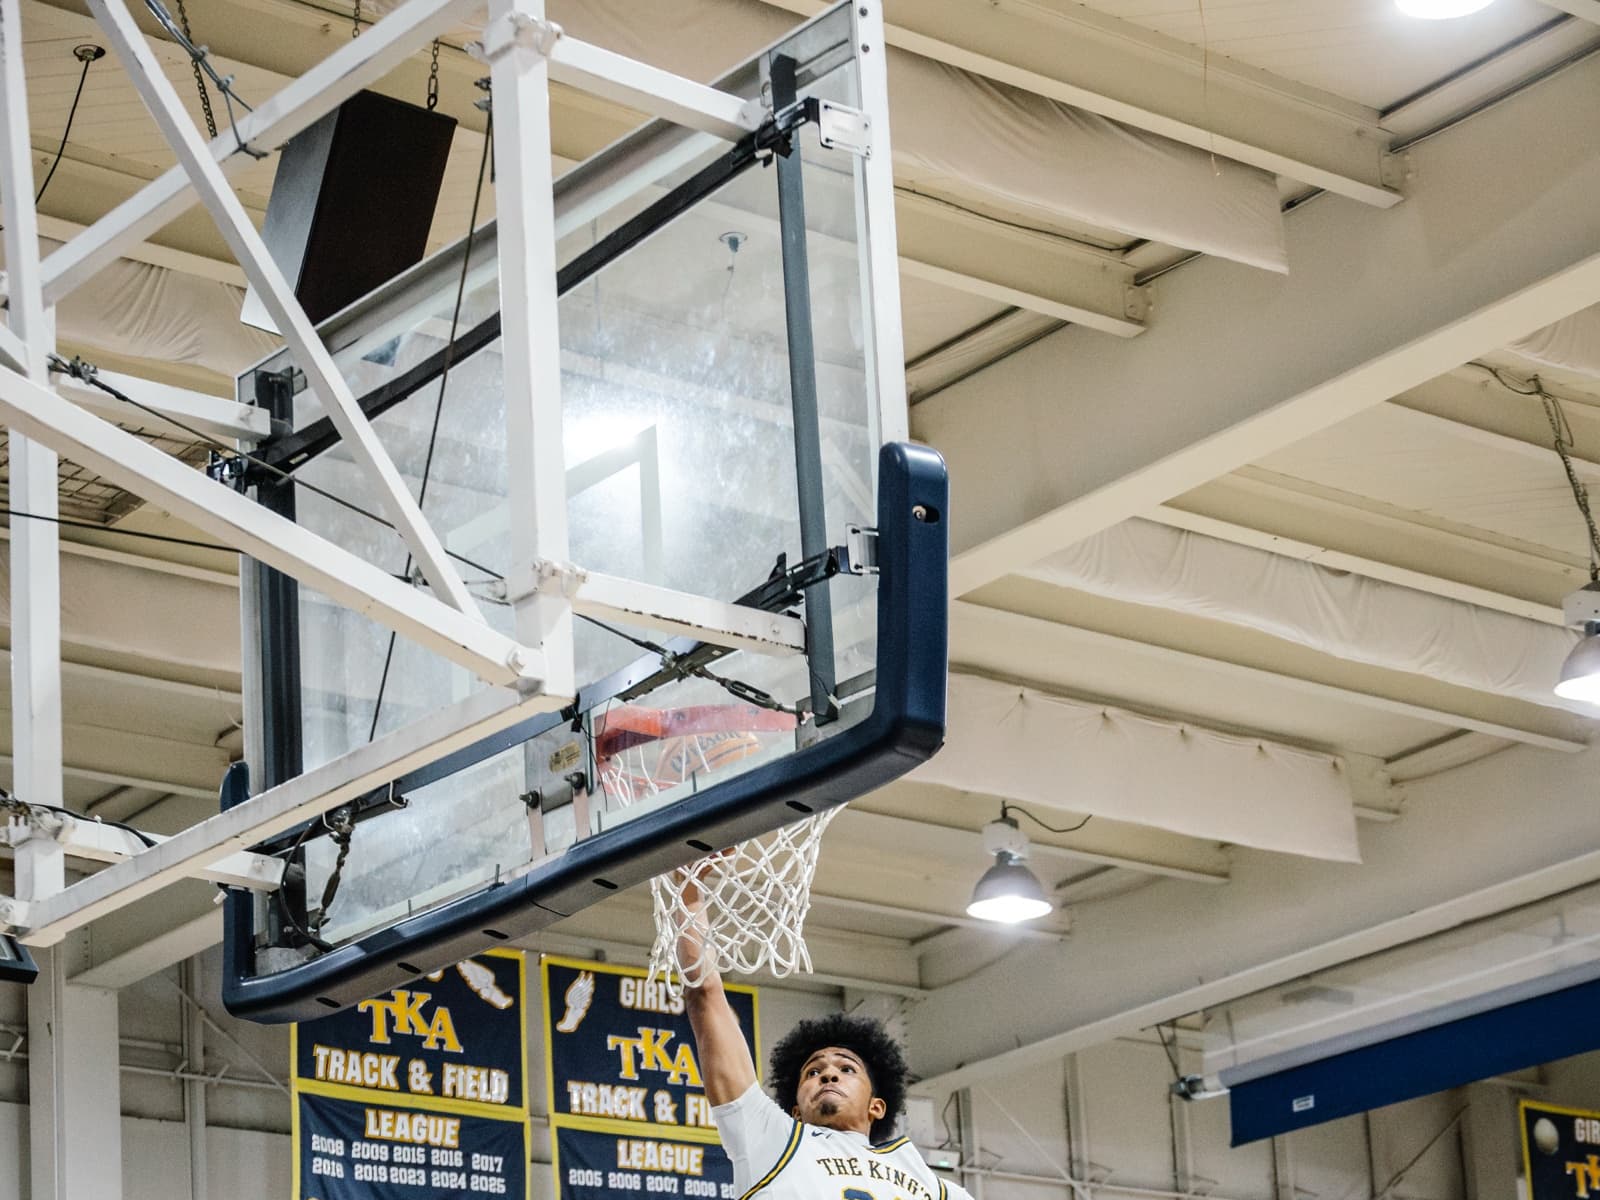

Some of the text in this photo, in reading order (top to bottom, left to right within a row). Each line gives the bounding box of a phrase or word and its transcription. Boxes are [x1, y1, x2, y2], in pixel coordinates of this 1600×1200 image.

[619, 976, 686, 1015] GIRLS
[358, 990, 464, 1053] TKA
[313, 1044, 509, 1104] TRACK & FIELD
[607, 1026, 705, 1087] TKA
[567, 1080, 648, 1122] TRACK
[654, 1089, 679, 1126] &
[365, 1109, 460, 1148] LEAGUE
[312, 1134, 503, 1173] 2008 2009 2015 2016 2017
[617, 1139, 704, 1176] LEAGUE
[817, 1157, 862, 1176] THE
[354, 1163, 388, 1182] 2019
[389, 1166, 426, 1186] 2023
[431, 1170, 467, 1190] 2024
[470, 1174, 506, 1193] 2025
[569, 1168, 603, 1187] 2005
[646, 1174, 678, 1194] 2007
